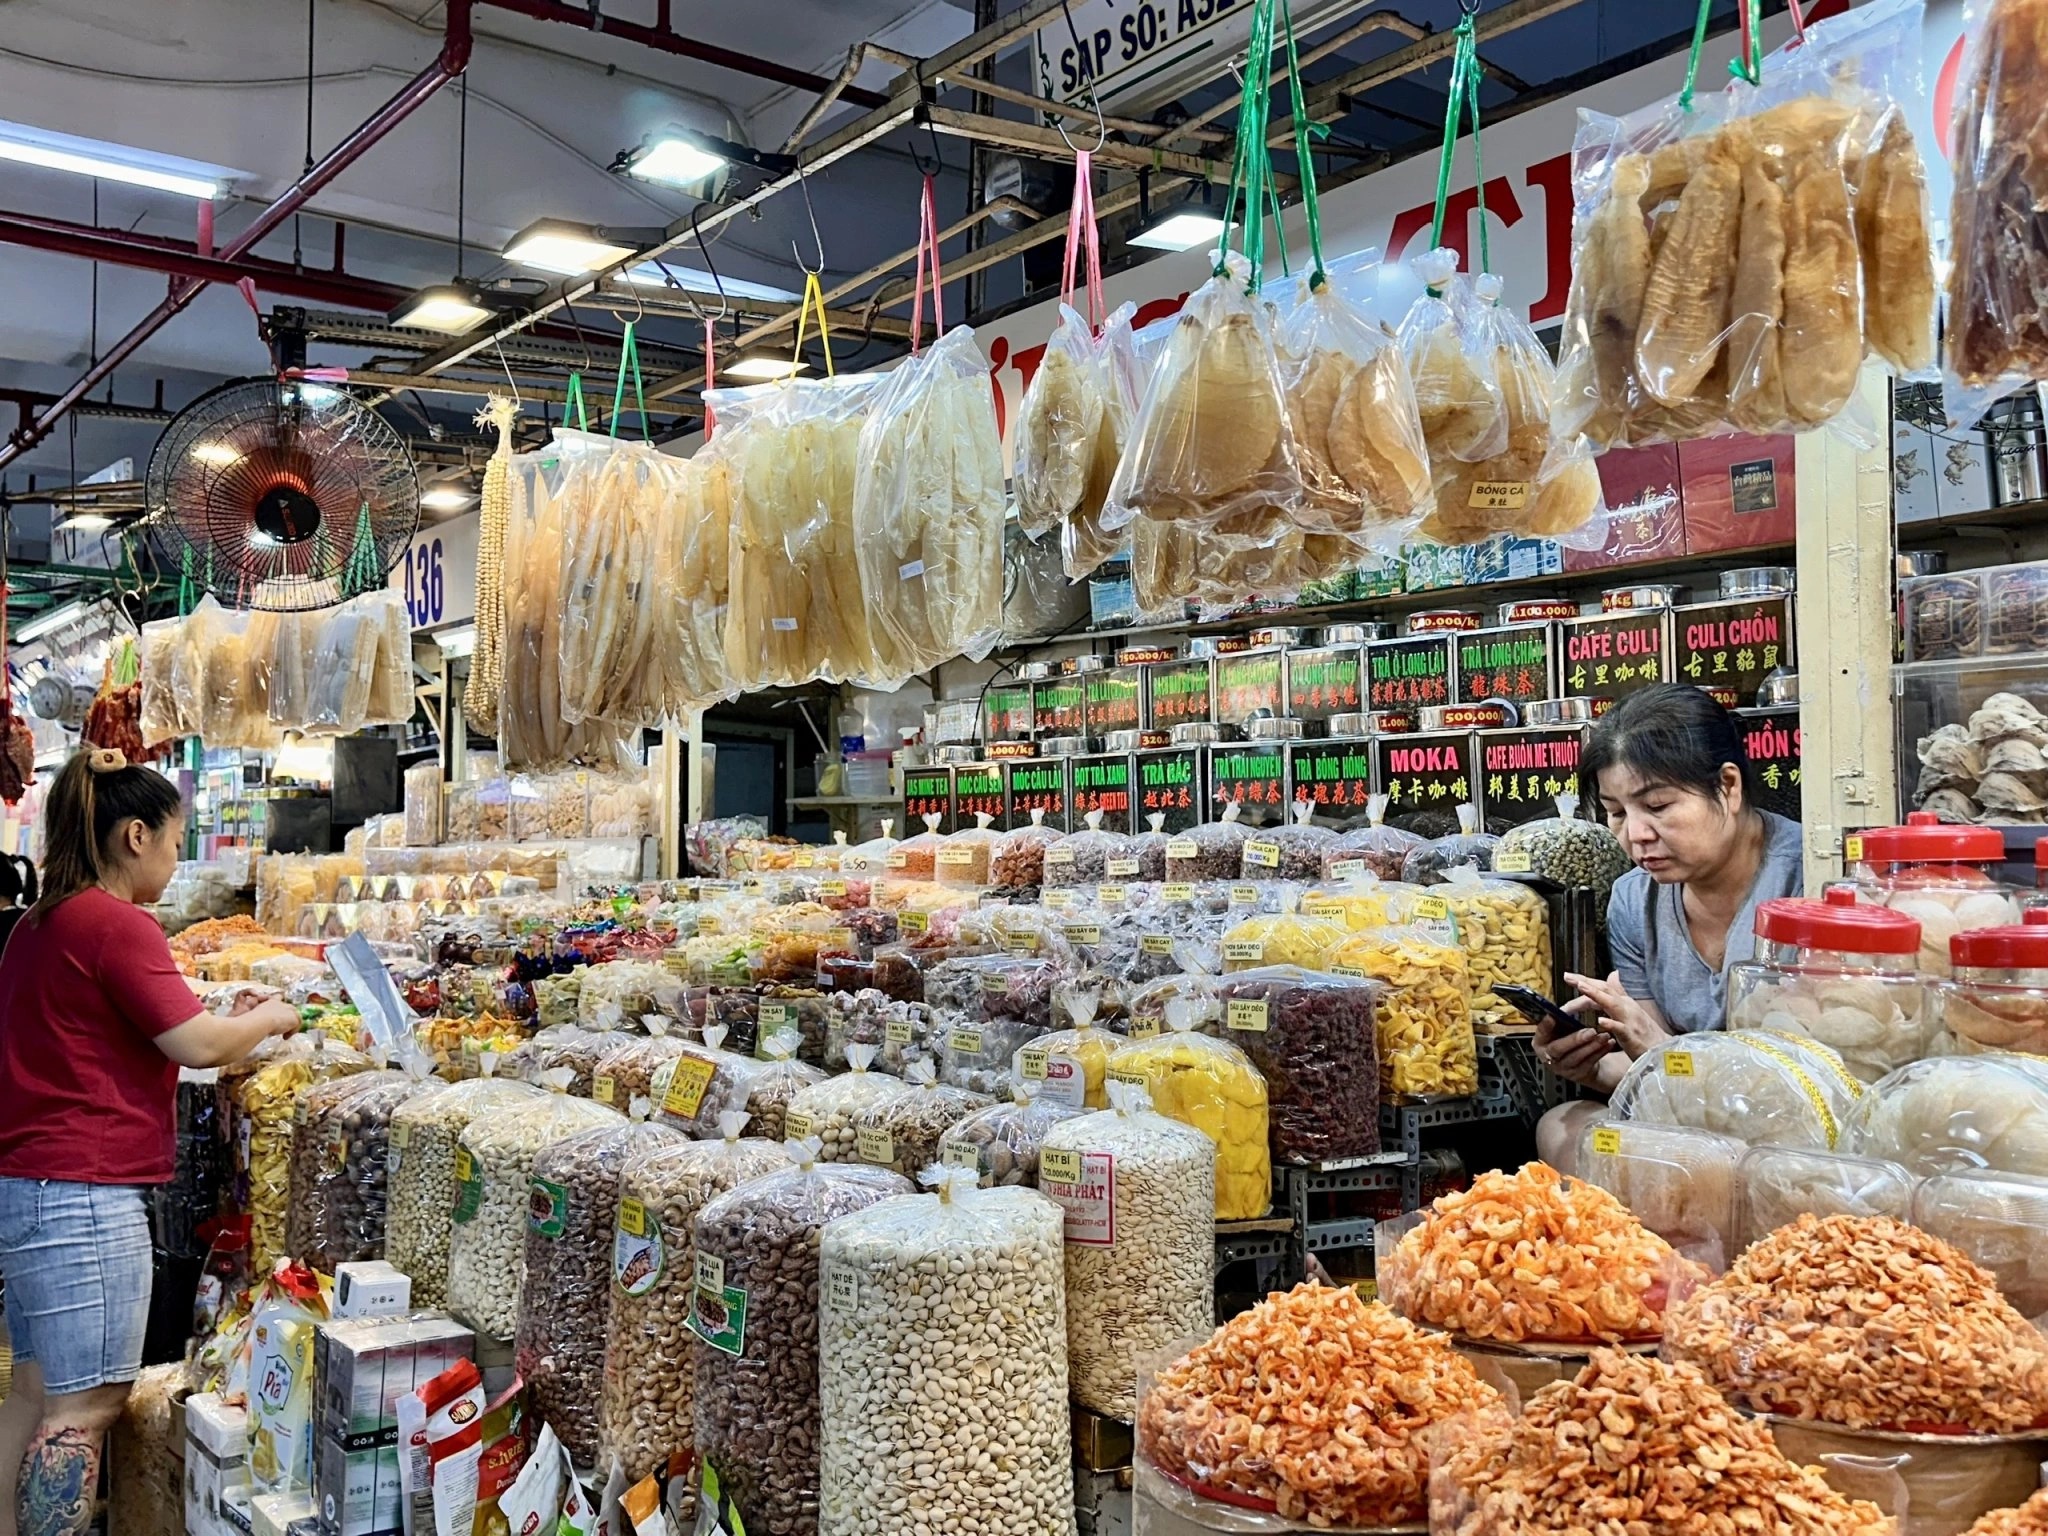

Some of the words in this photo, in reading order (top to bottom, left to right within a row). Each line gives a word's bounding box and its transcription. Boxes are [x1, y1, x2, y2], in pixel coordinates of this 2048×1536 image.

[1616, 628, 1658, 656] CULI
[1686, 622, 1725, 650] CULI
[1728, 606, 1778, 646] CHỒN
[1372, 651, 1392, 679] TRÀ
[1401, 651, 1427, 677] LONG
[1462, 640, 1483, 669] TRÀ
[1484, 642, 1512, 668] LONG
[1302, 665, 1324, 686] LONG
[1568, 657, 1658, 690] 古里咖啡
[1215, 752, 1230, 780] TRÀ
[1231, 751, 1249, 779] THÁI
[1249, 752, 1281, 779] NGUYÊN
[1295, 753, 1313, 781] TRÀ
[1315, 752, 1339, 780] BÔNG
[1342, 746, 1367, 779] HỒNG
[1390, 746, 1458, 773] MOKA
[1486, 742, 1507, 770] CAFE
[1508, 737, 1533, 769] BUÔN
[1534, 743, 1548, 768] ME
[1549, 734, 1579, 771] THUỘT
[957, 771, 973, 794] MÓC
[973, 771, 988, 794] CÂU
[988, 775, 1003, 794] SEN
[1012, 766, 1030, 791] MÓC
[1031, 766, 1047, 790] CÂU
[1048, 764, 1062, 789] LÀI
[1090, 760, 1105, 786] TRÀ
[1106, 764, 1127, 785] XANH
[1142, 759, 1164, 785] TRÀ
[1167, 754, 1190, 784] BẮC
[935, 777, 949, 796] TEA
[1117, 791, 1128, 810] TEA
[1387, 777, 1469, 805] 摩卡咖啡
[1045, 1153, 1059, 1165] HẠT
